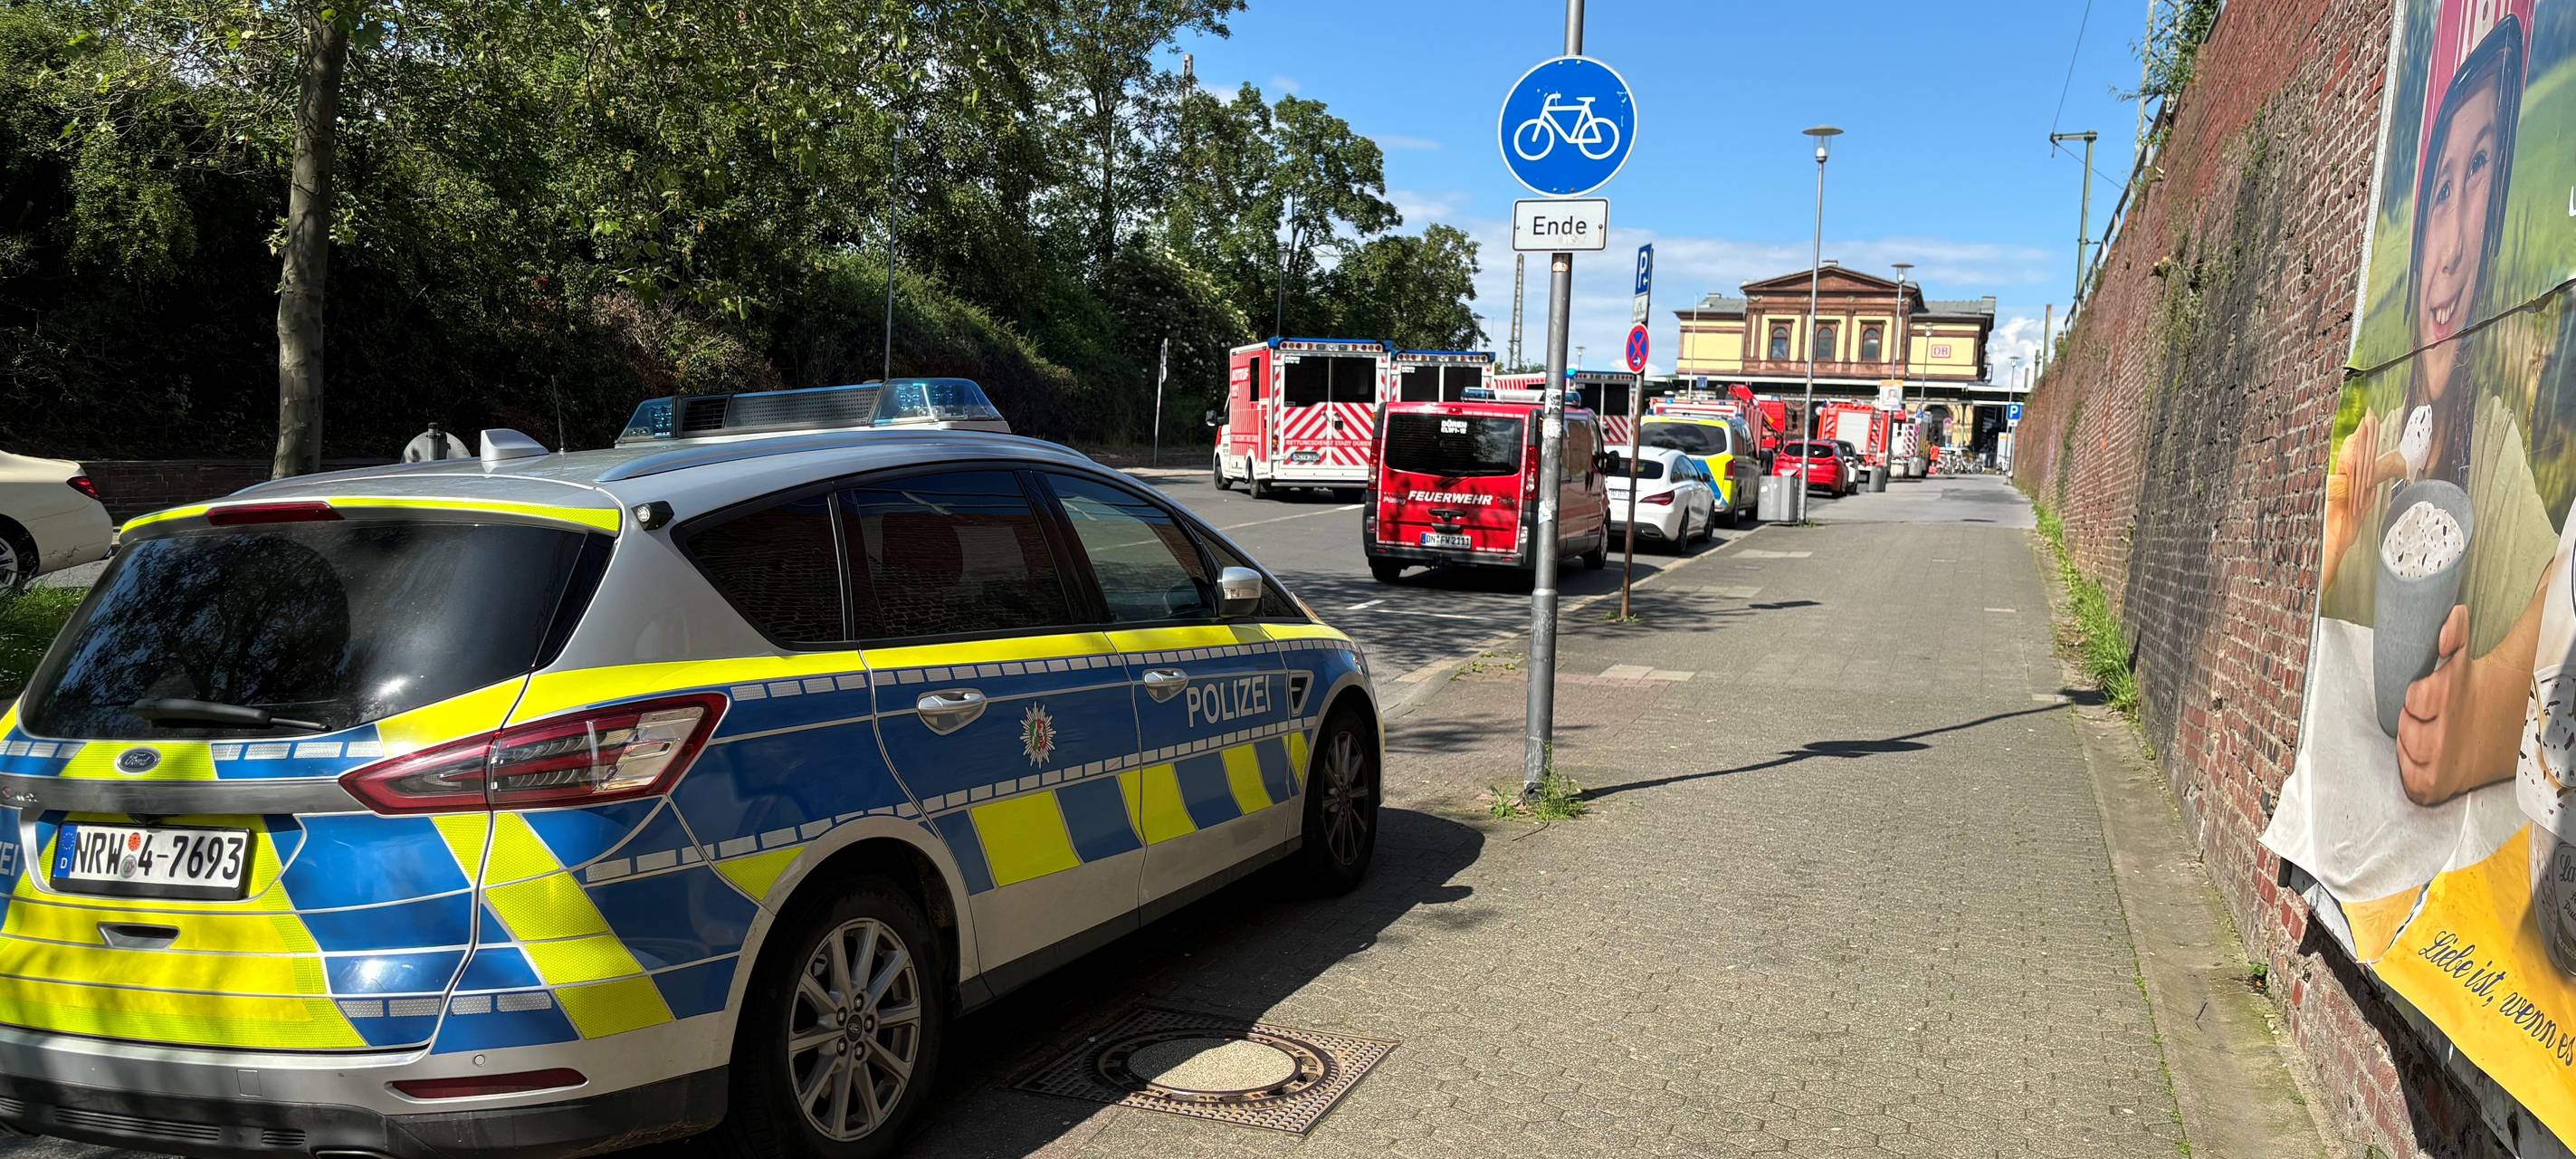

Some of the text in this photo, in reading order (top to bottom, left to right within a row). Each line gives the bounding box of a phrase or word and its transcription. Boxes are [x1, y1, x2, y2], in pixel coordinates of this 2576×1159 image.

[1532, 216, 1587, 235] Ende
[1637, 251, 1648, 289] P
[1933, 347, 1949, 356] DB
[2009, 405, 2019, 418] P
[1407, 490, 1493, 505] FEUERWEHR
[1451, 536, 1470, 546] 2111
[1187, 675, 1271, 728] POLIZEI
[123, 752, 152, 768] Ford
[0, 840, 20, 876] EI
[60, 831, 243, 880] D NRW 4-7693
[2418, 930, 2476, 979] Liebe
[2464, 960, 2506, 1008] ist,
[2499, 991, 2557, 1049] wenn
